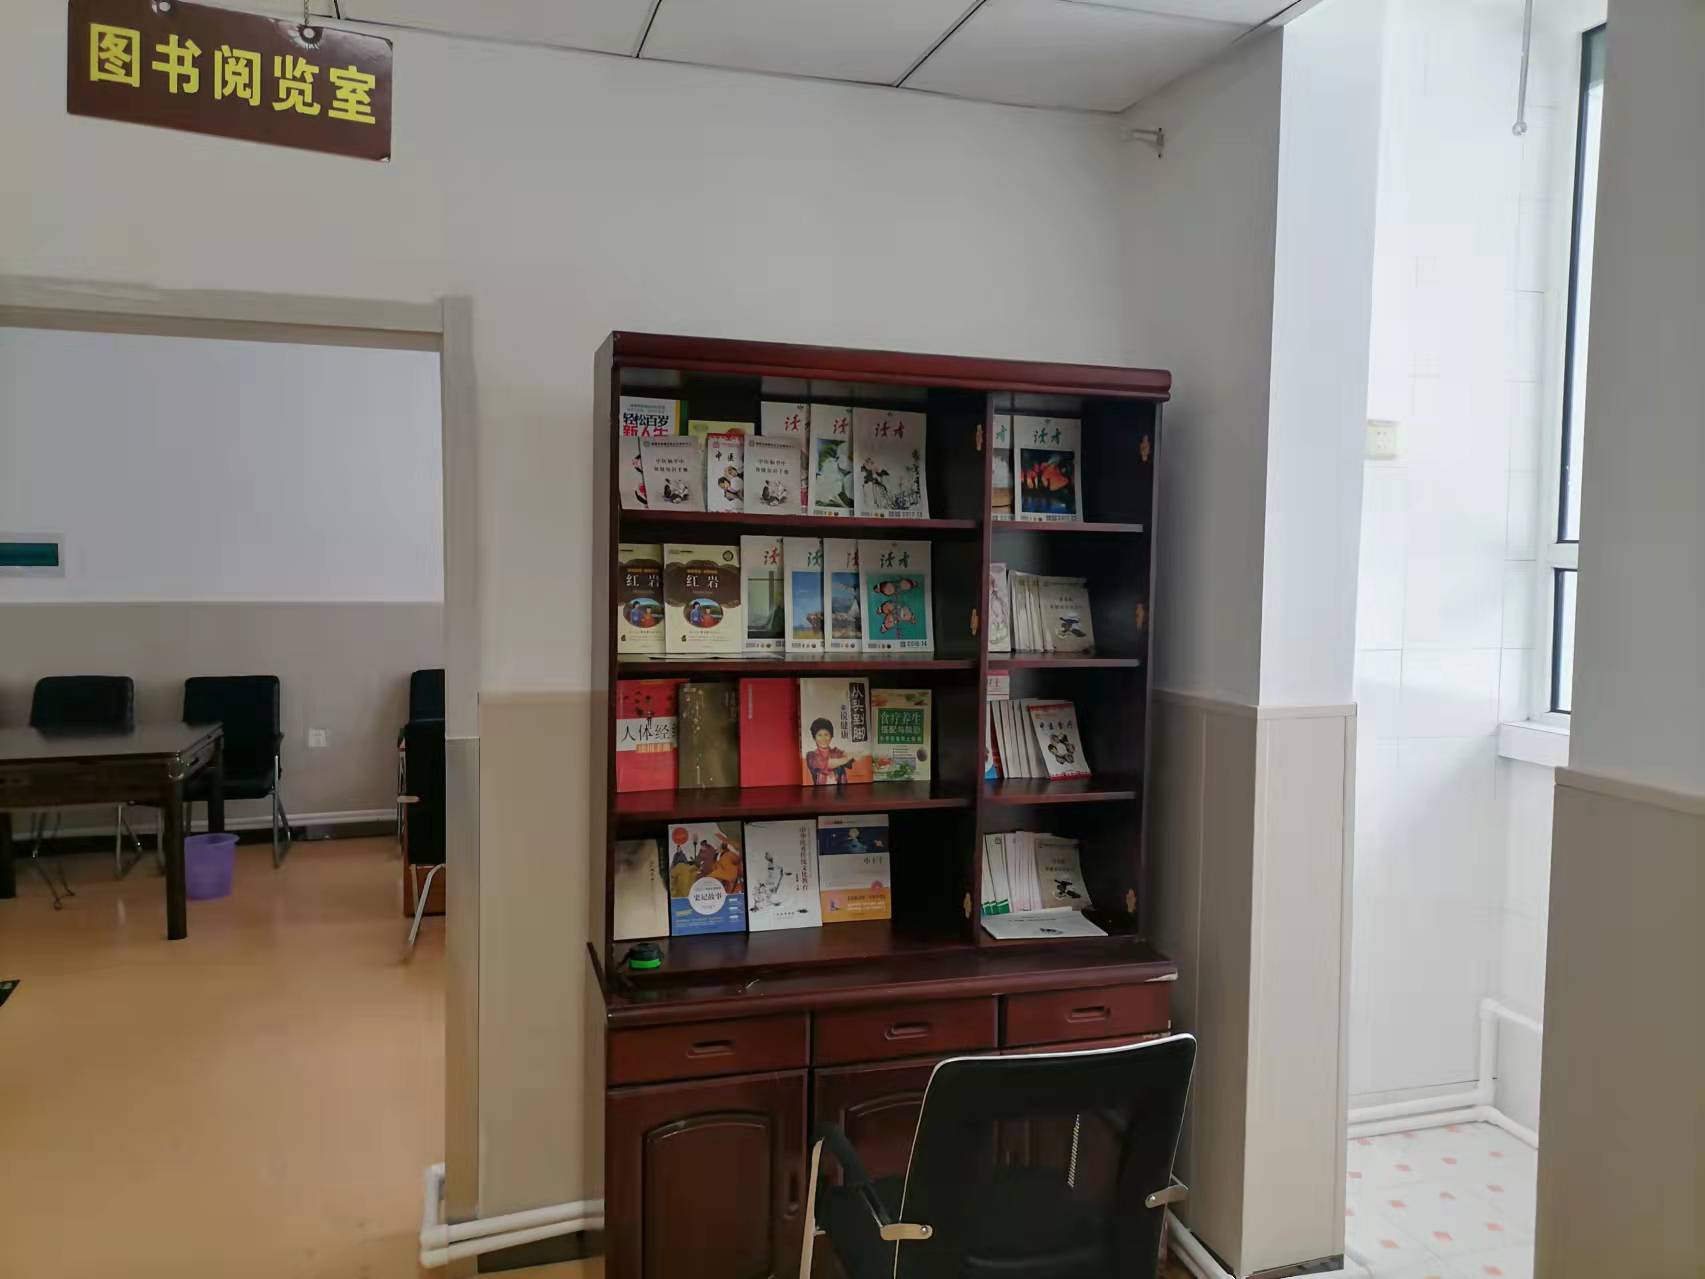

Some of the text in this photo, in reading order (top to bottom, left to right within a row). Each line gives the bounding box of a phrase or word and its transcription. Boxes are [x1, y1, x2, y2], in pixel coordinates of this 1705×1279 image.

[88, 22, 376, 124] 图书阅览室
[623, 412, 669, 426] 轻松百岁
[874, 420, 905, 440] 读者
[1033, 427, 1063, 445] 读者
[880, 550, 911, 569] 读者
[686, 573, 720, 589] 红岩
[850, 684, 866, 743] 从头到脚
